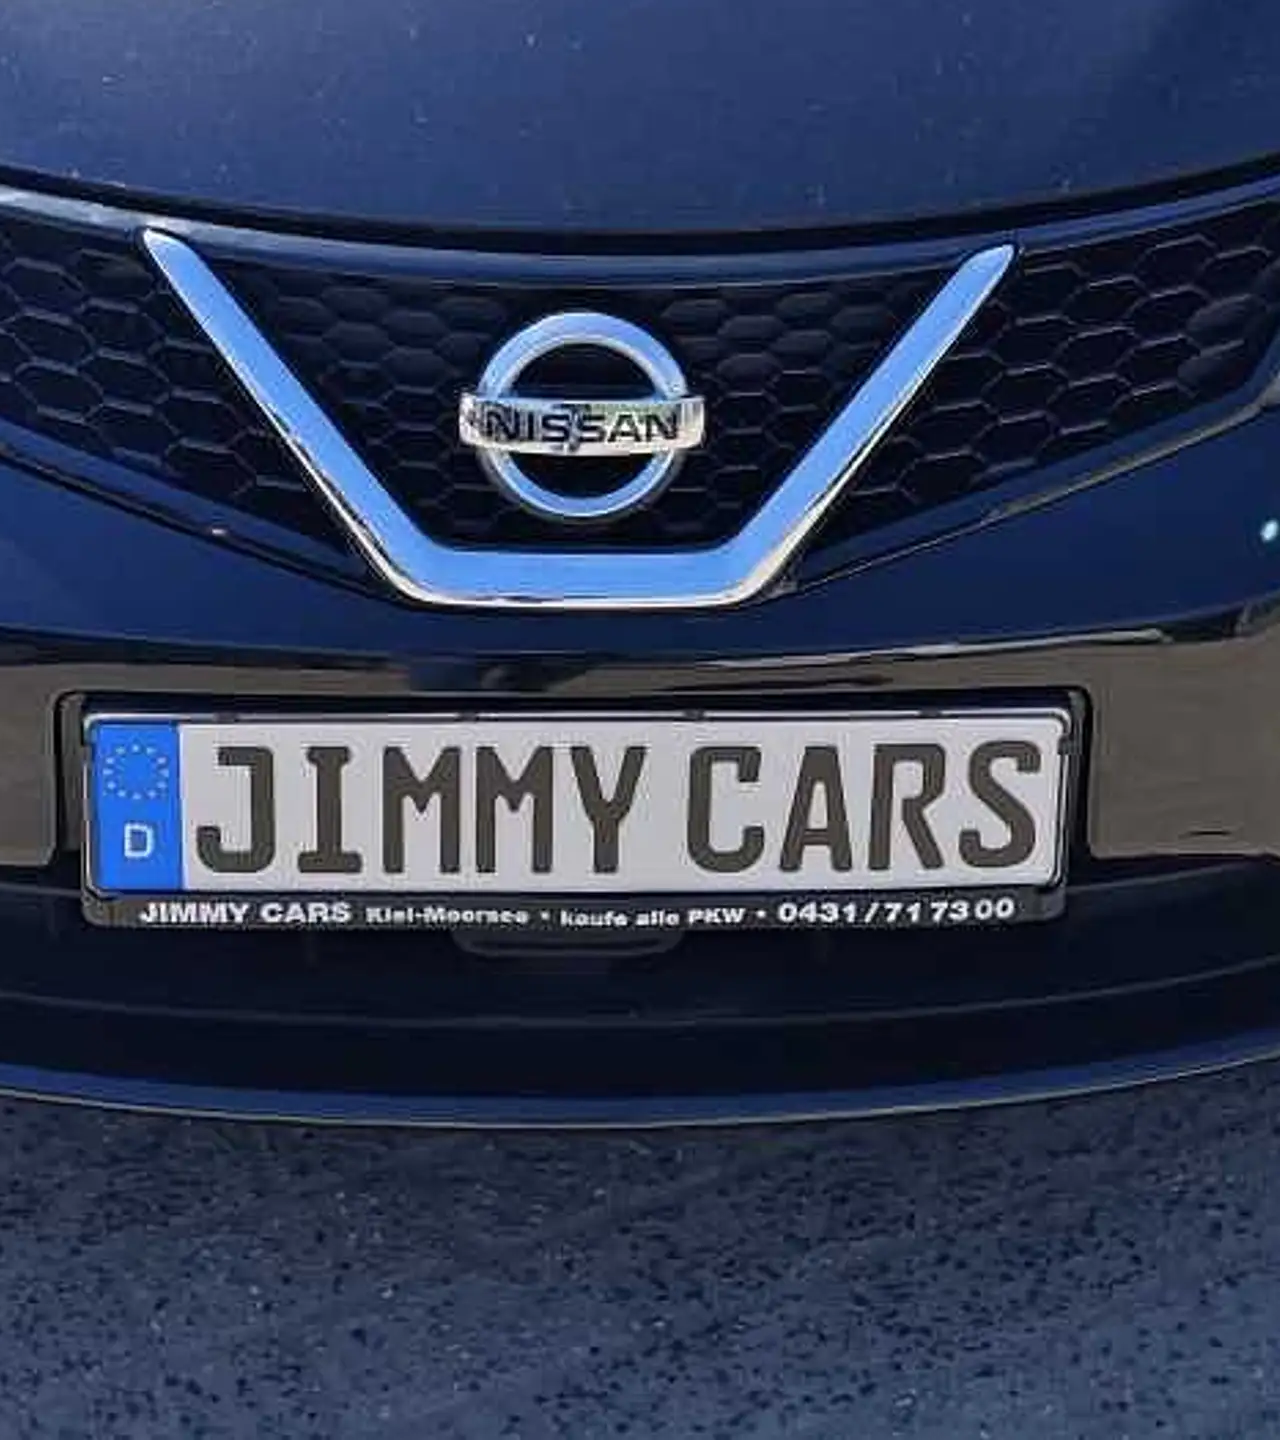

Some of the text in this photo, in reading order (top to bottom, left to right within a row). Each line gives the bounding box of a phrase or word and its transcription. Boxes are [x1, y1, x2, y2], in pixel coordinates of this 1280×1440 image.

[484, 410, 678, 443] NISSAN
[195, 740, 1042, 874] JIMMY CARS
[123, 823, 155, 858] D
[139, 902, 250, 923] JIMMY
[260, 902, 352, 922] CARS
[687, 907, 746, 924] PKW
